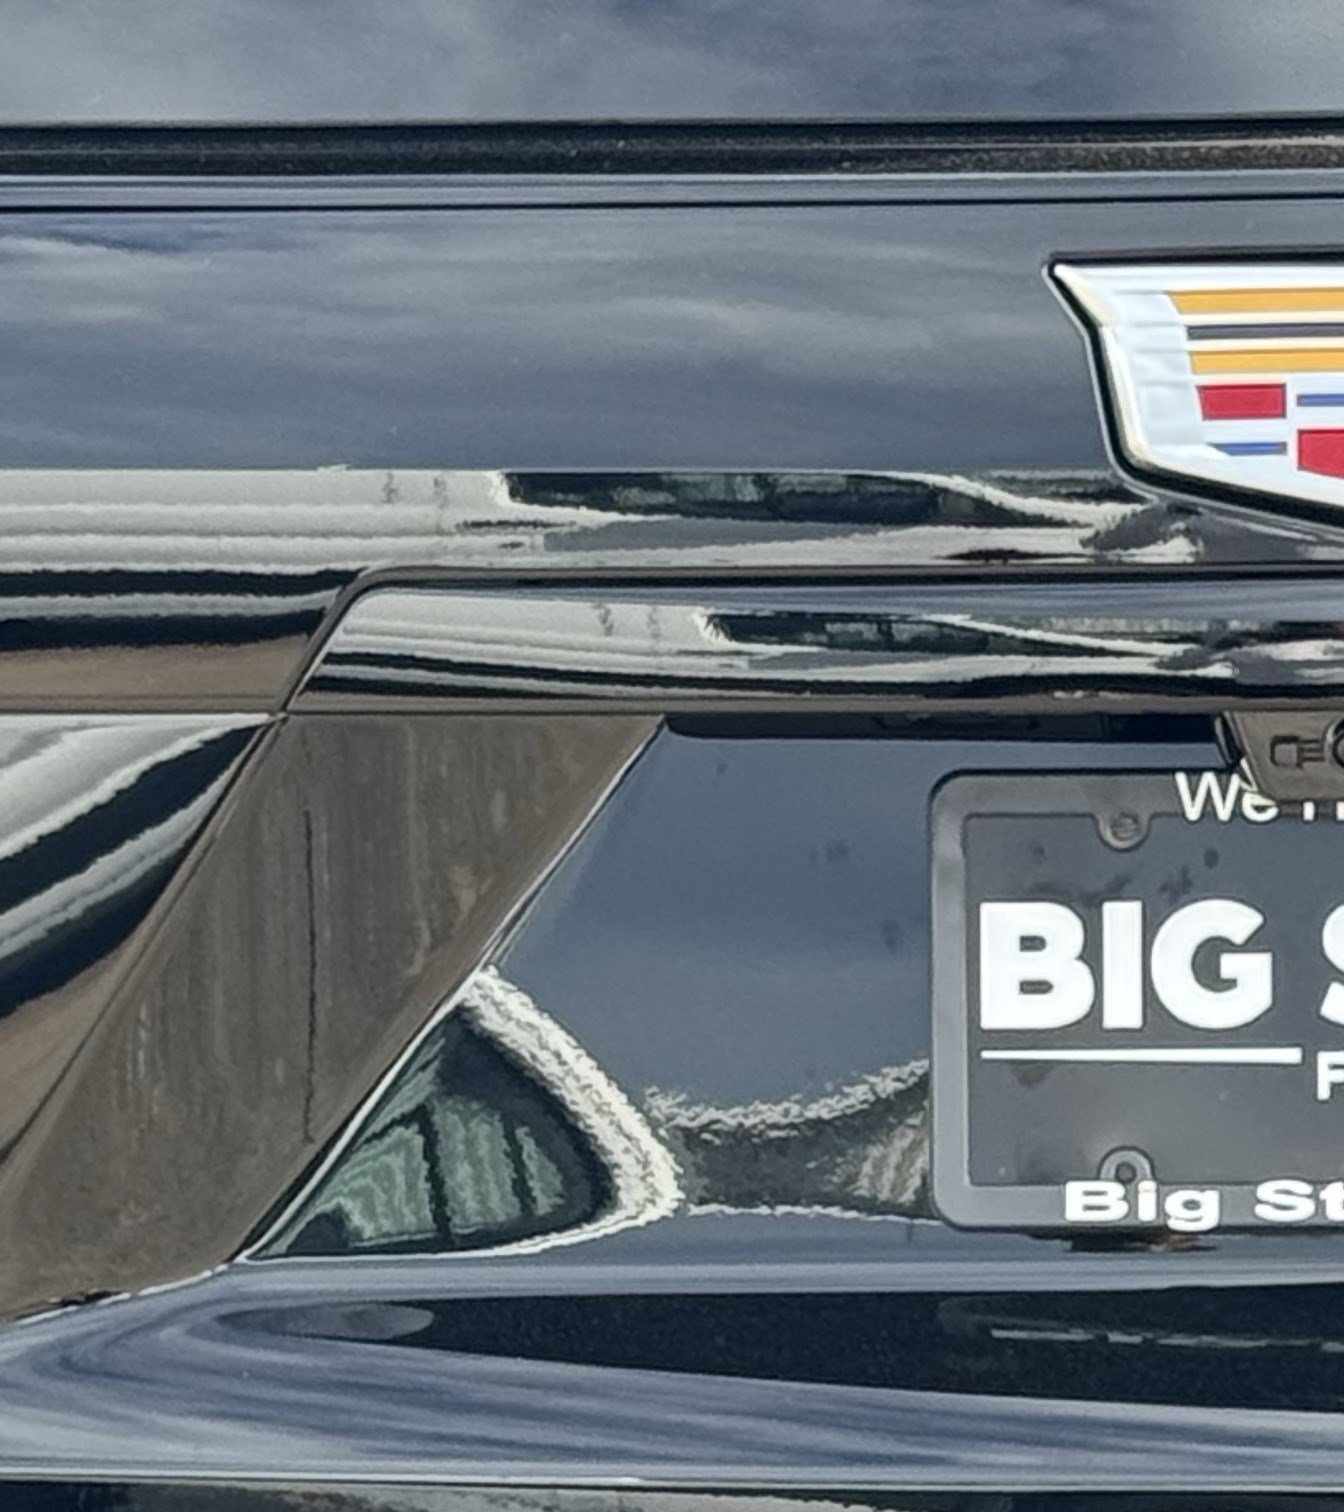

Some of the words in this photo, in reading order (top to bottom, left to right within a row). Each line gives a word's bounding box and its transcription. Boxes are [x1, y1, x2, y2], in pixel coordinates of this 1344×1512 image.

[1175, 771, 1279, 822] We
[978, 898, 1274, 1031] BIG
[1063, 1179, 1220, 1231] Big
